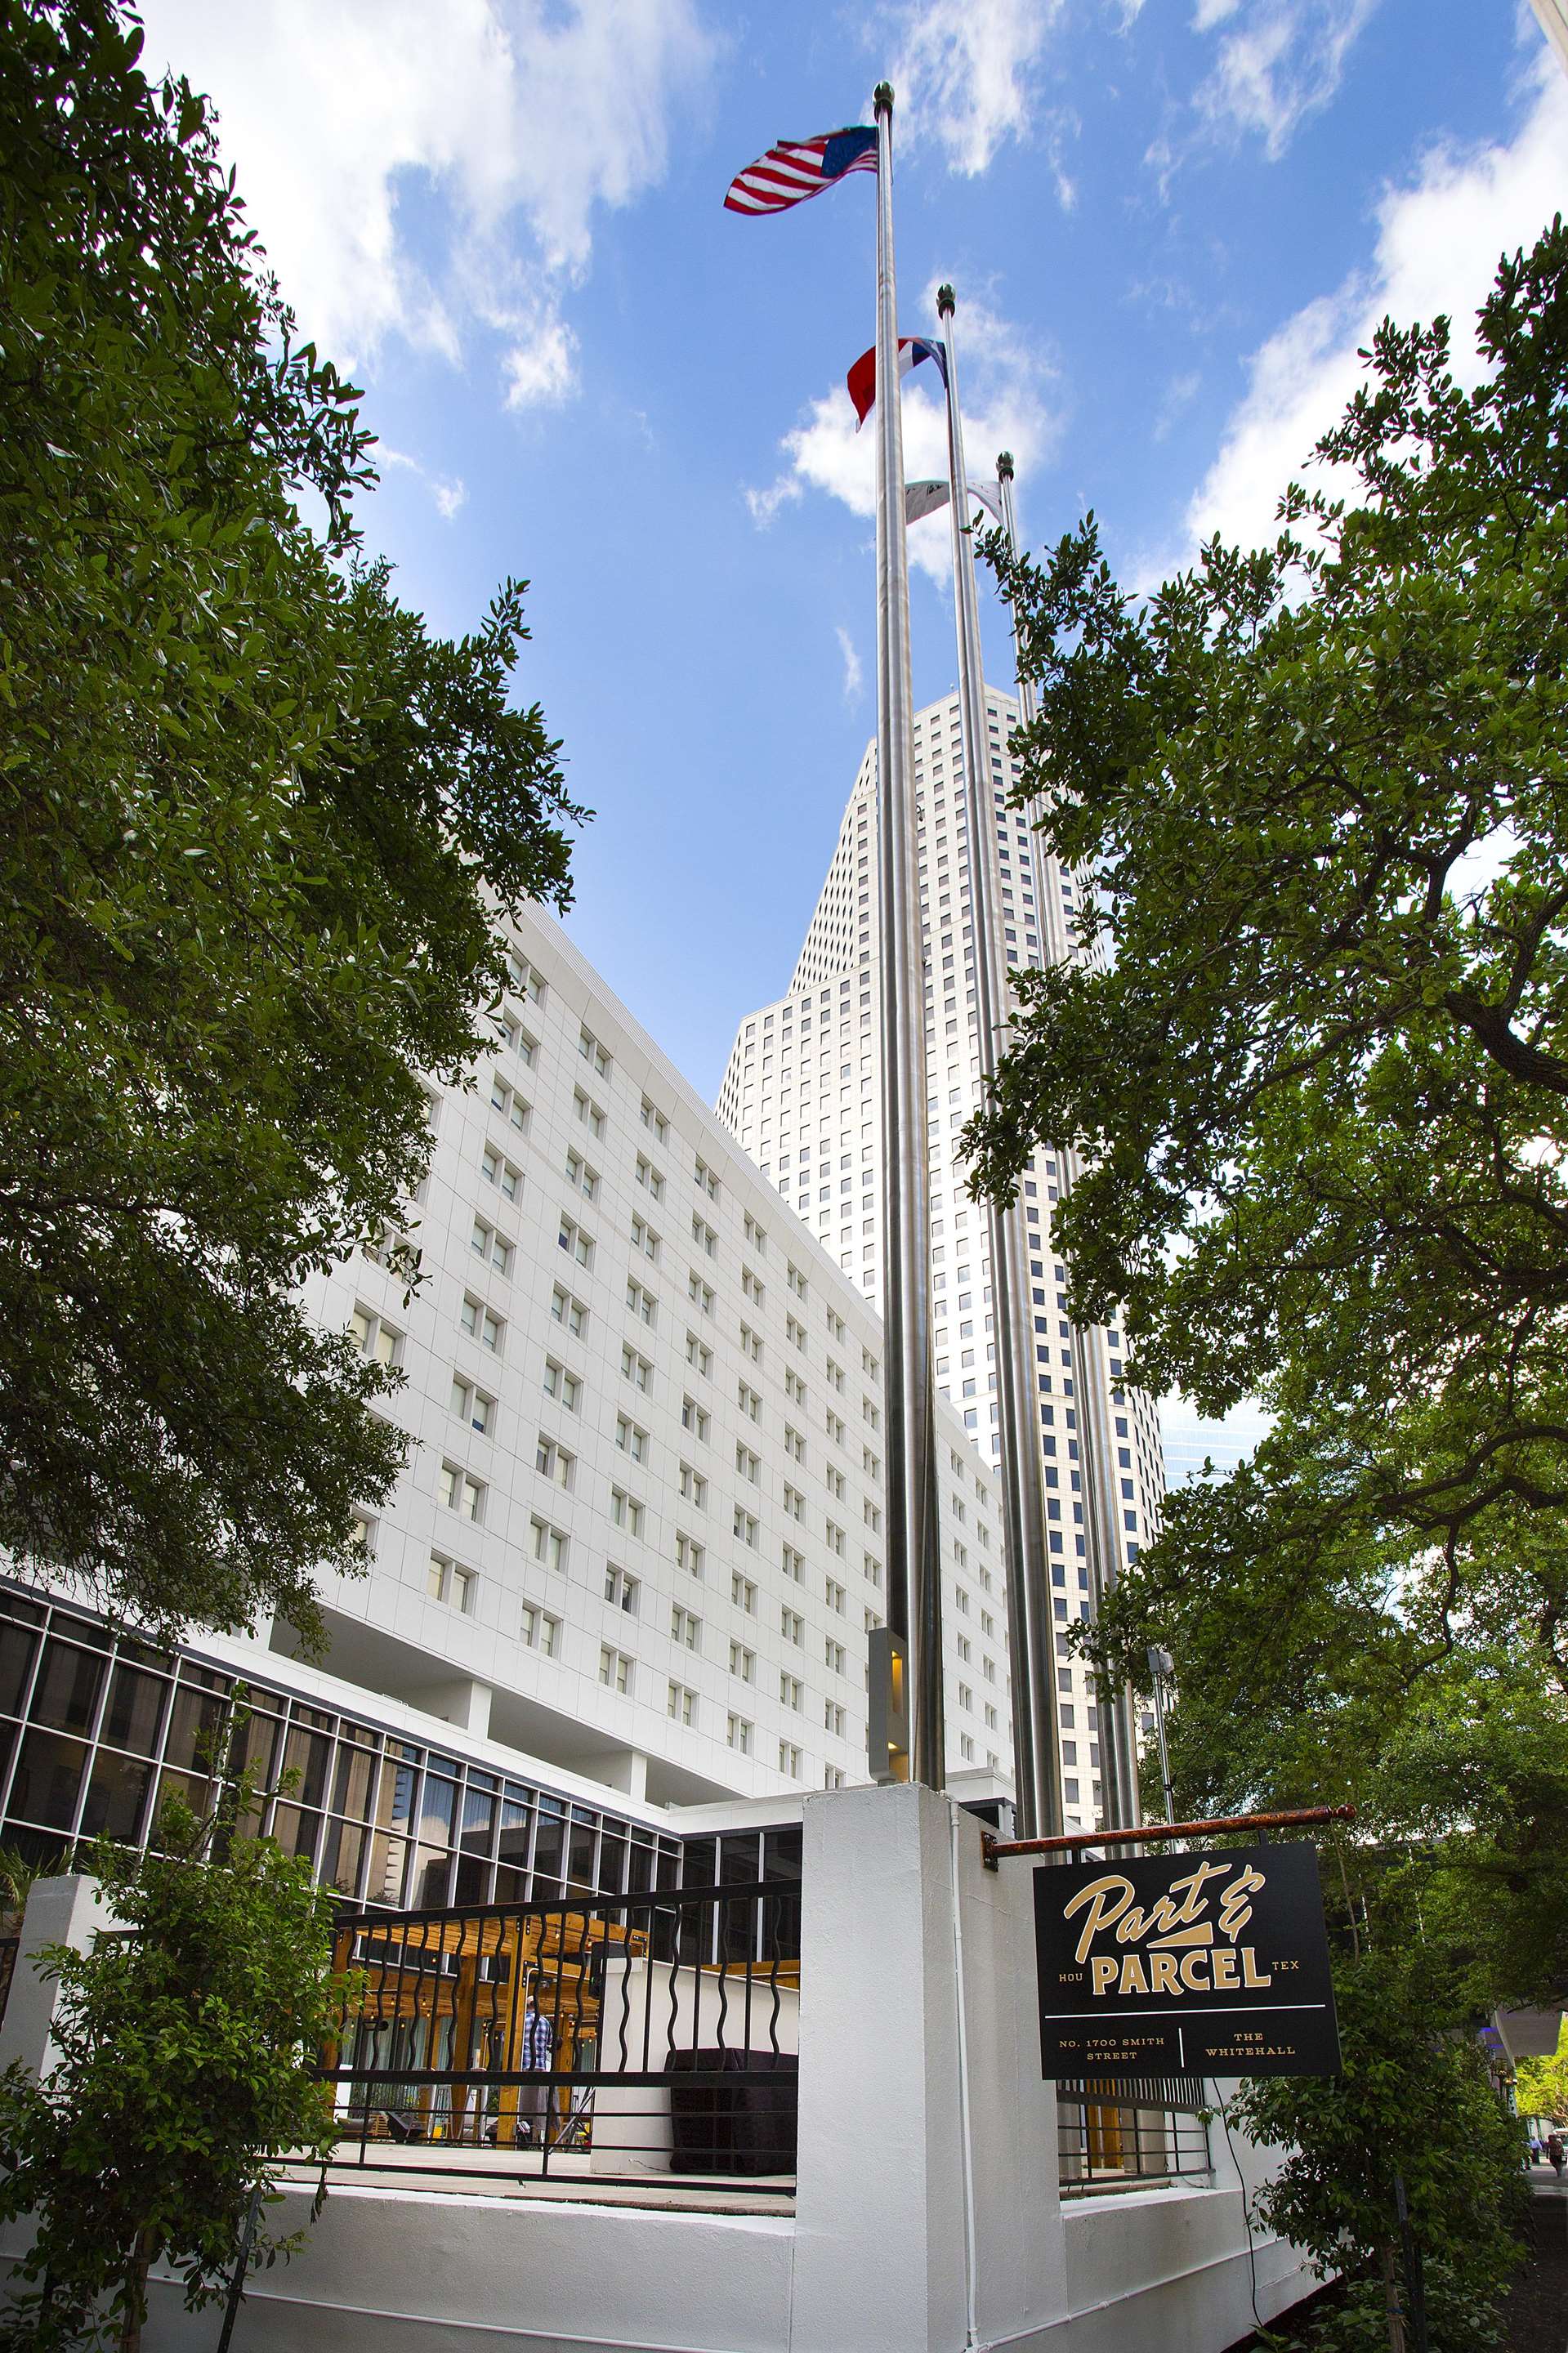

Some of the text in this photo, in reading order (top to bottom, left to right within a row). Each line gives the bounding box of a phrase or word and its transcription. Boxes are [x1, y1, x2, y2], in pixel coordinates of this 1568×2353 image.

[1063, 1861, 1266, 1964] Part &
[1271, 1960, 1300, 1971] TEX
[1091, 1947, 1272, 1995] PARCEL
[1058, 1972, 1083, 1983] HOU
[1086, 2038, 1117, 2047] 1700
[1122, 2038, 1164, 2047] SMITH
[1233, 2033, 1263, 2042] THE
[1205, 2046, 1296, 2056] WHITEHALL
[1087, 2052, 1137, 2061] STREET
